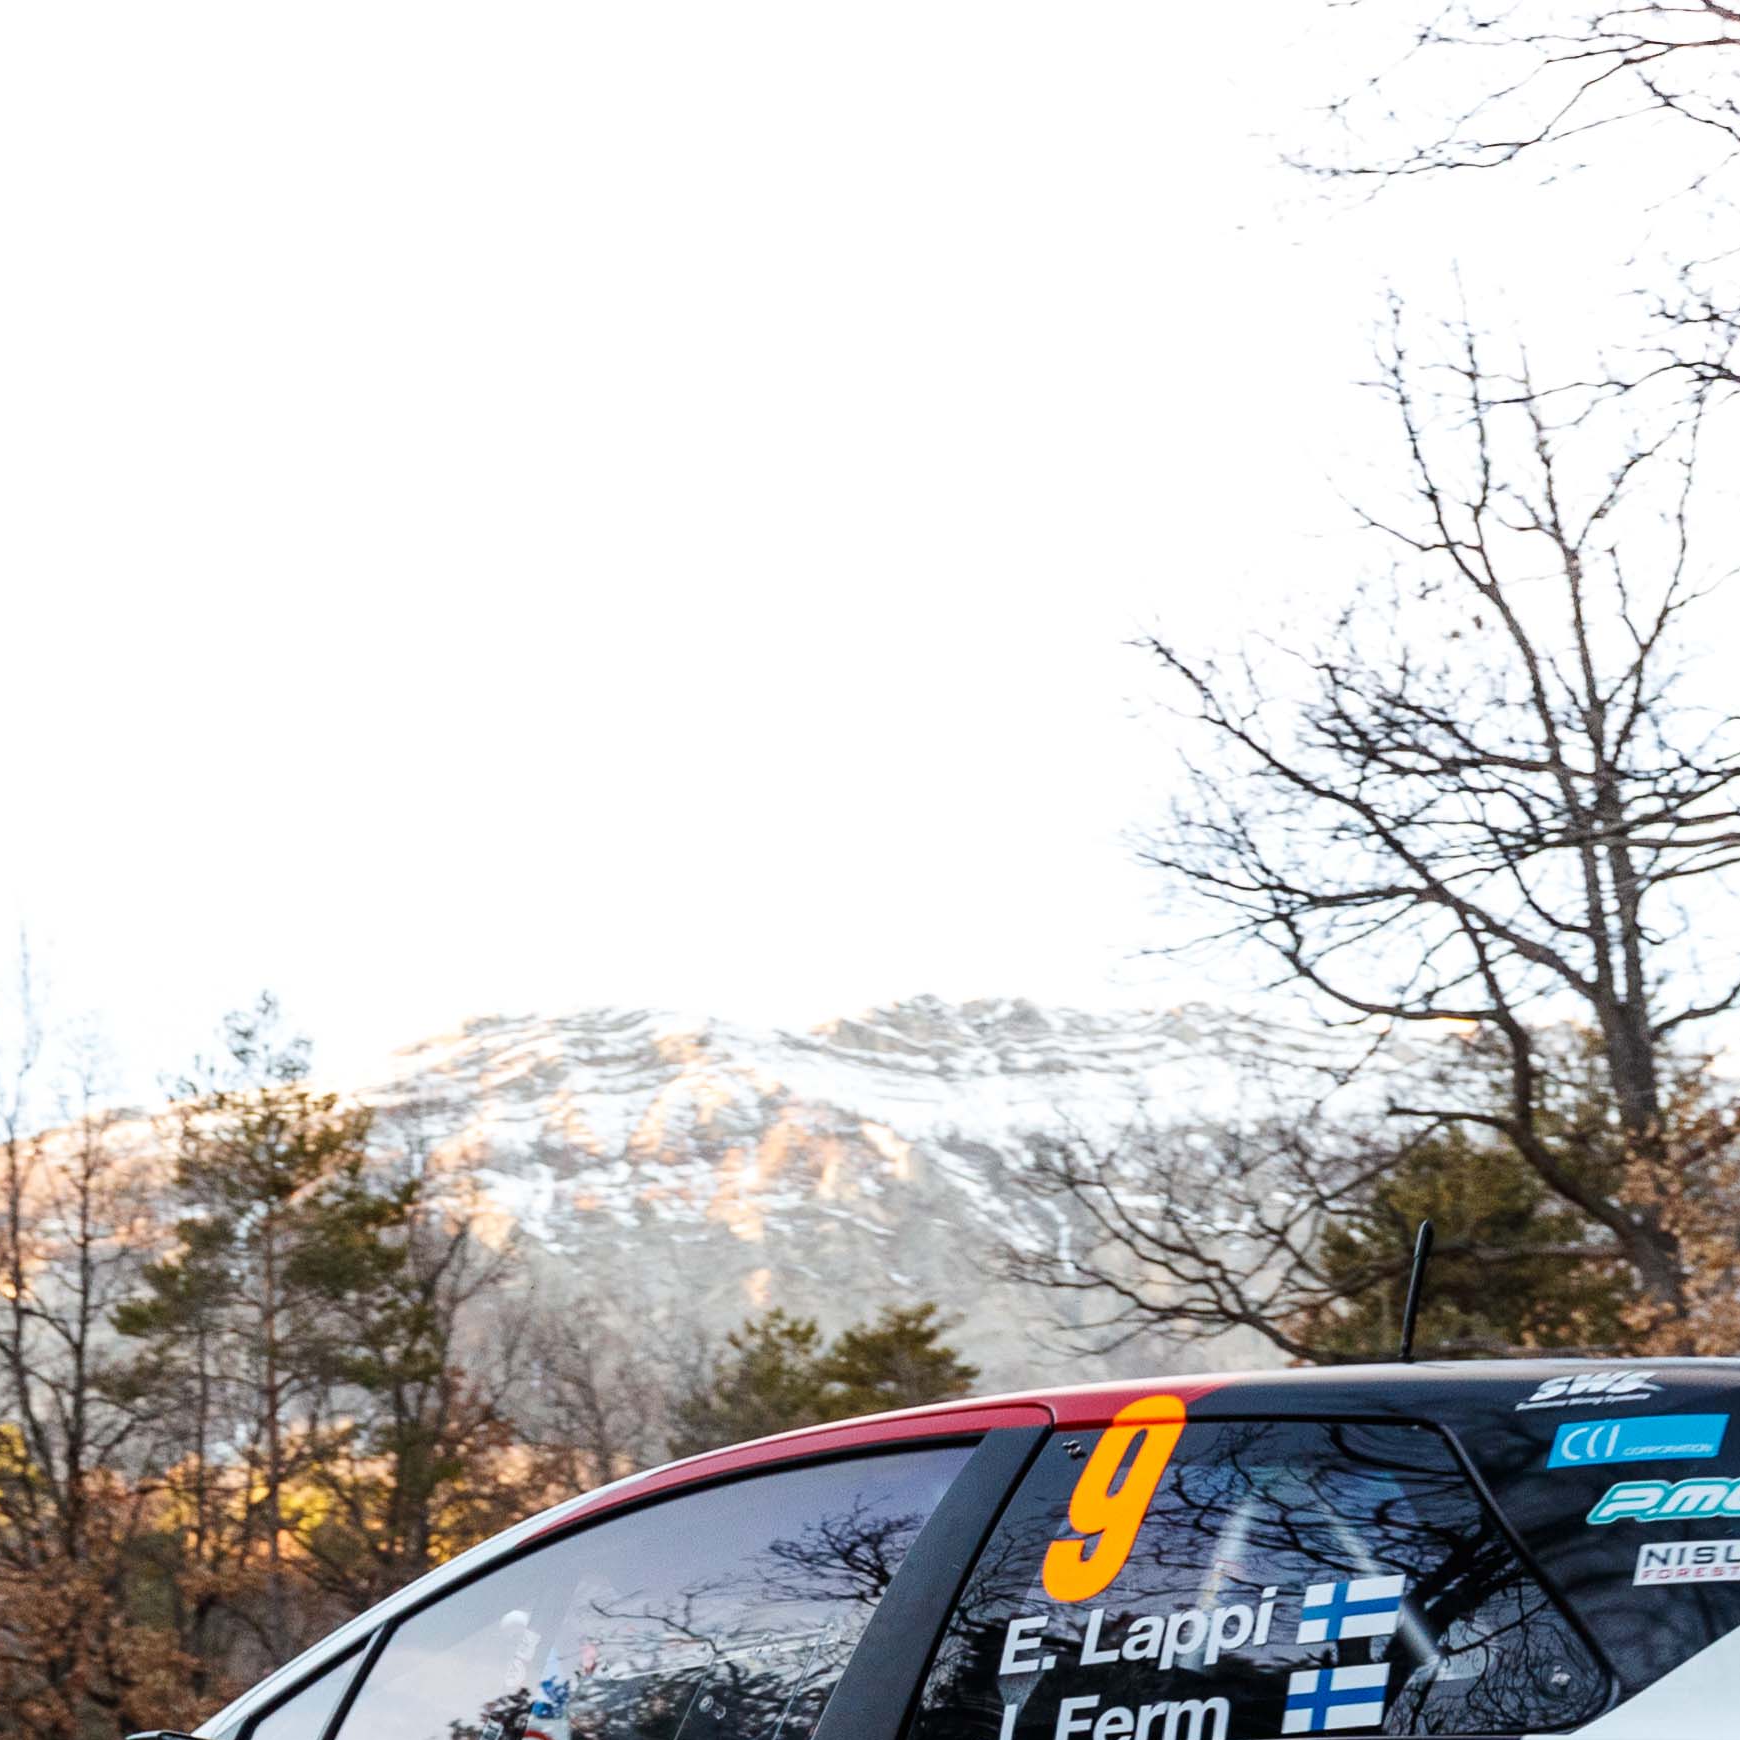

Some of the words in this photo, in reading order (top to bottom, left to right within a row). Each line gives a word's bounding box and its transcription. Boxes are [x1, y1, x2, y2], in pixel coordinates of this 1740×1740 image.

[1042, 1395, 1186, 1602] 9
[998, 1615, 1055, 1675] E.
[1079, 1586, 1277, 1671] Lappi
